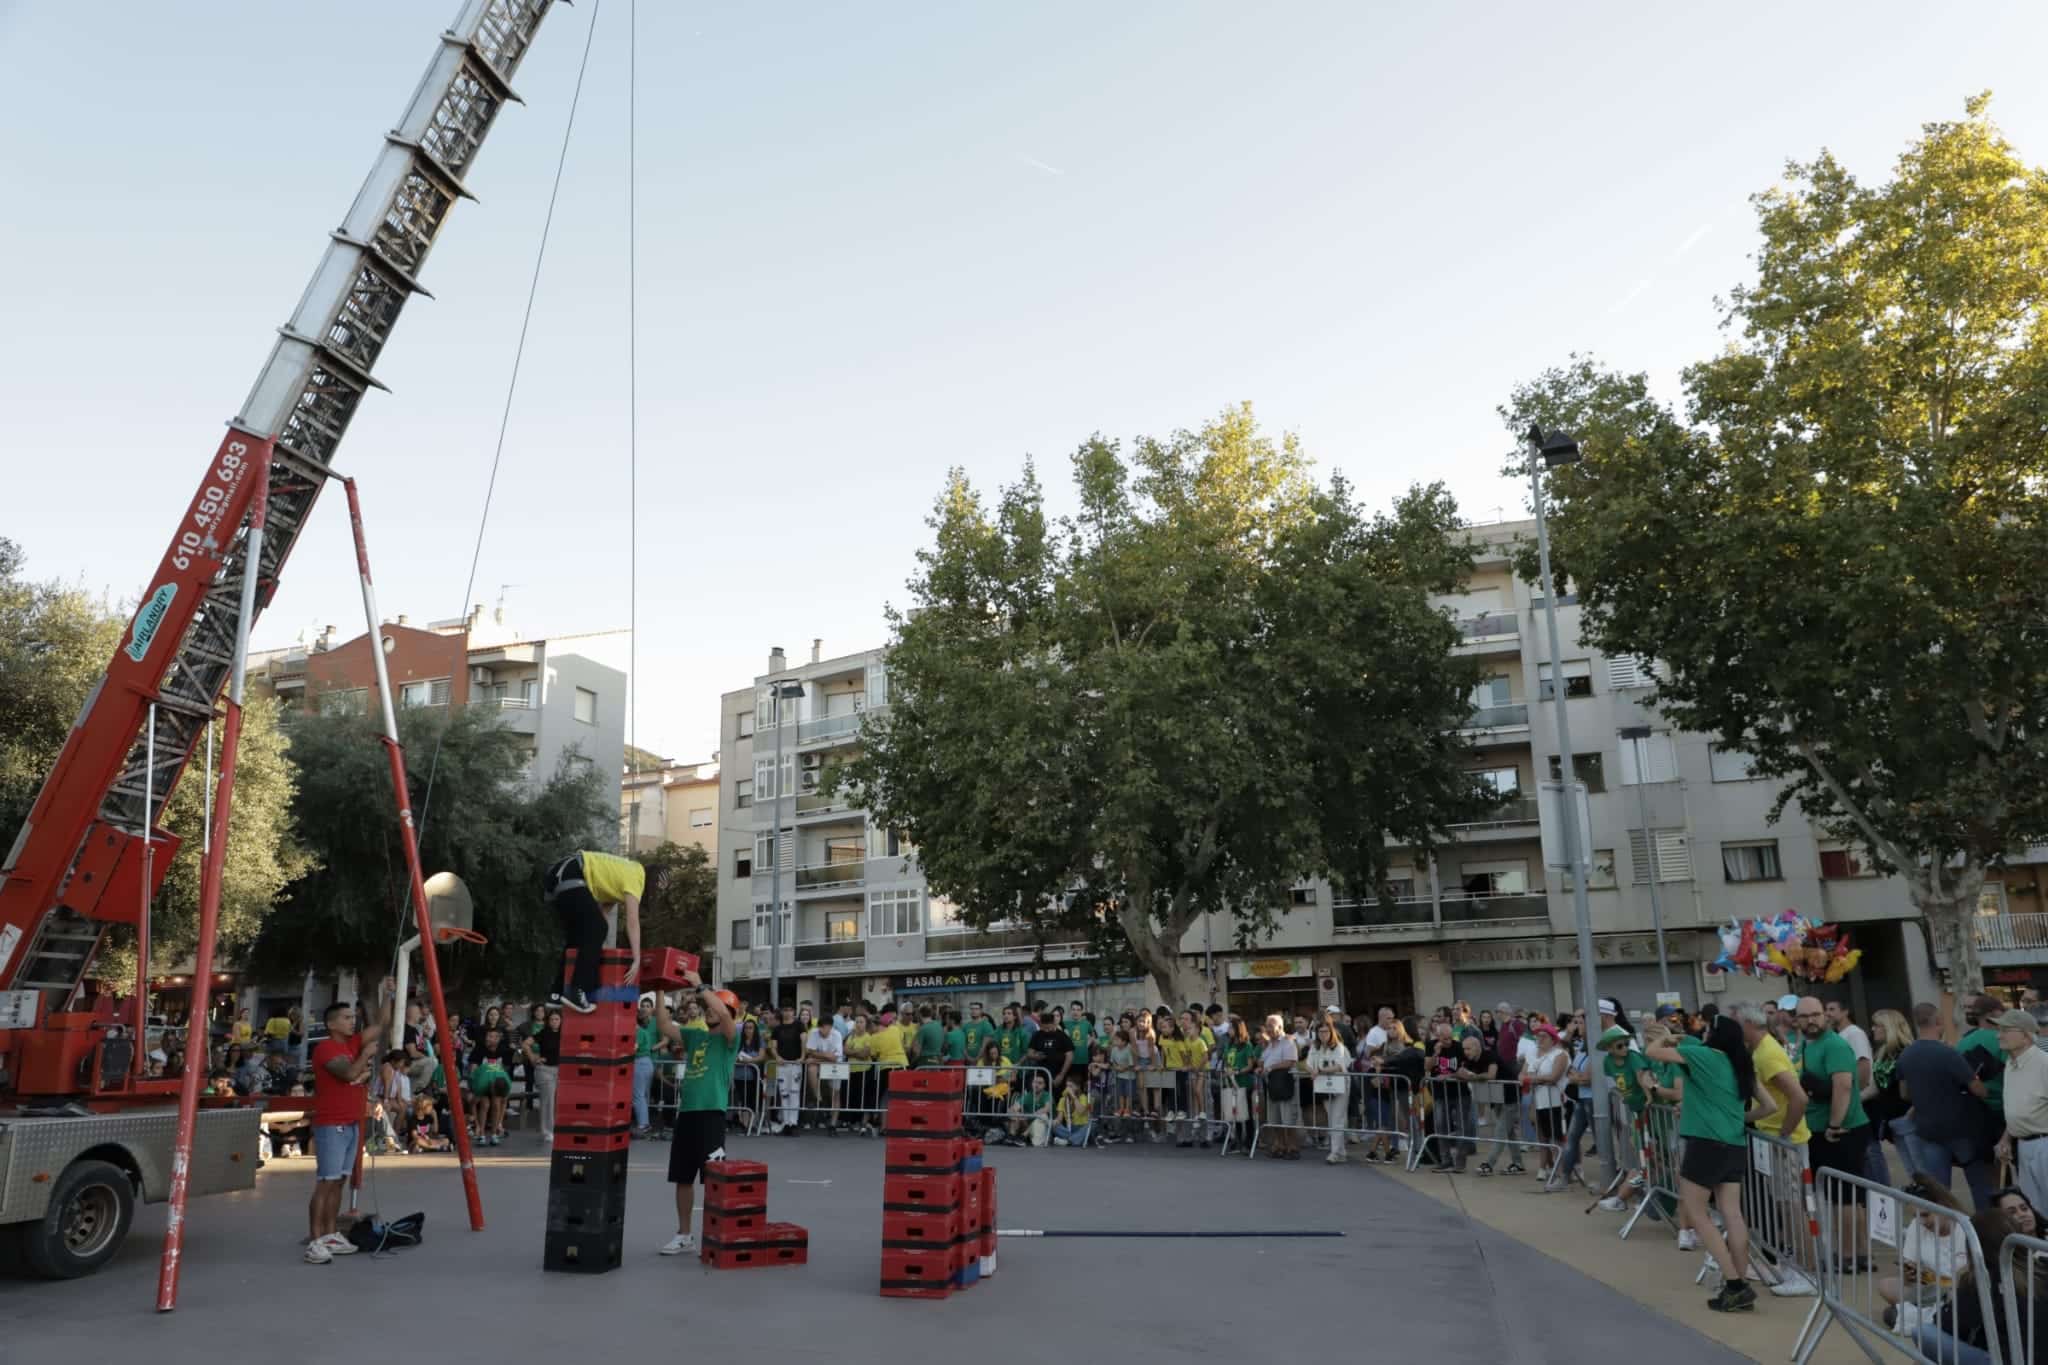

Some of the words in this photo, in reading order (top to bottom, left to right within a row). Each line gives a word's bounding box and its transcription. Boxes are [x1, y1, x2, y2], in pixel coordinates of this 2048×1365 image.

[172, 531, 201, 570] 610
[194, 486, 225, 528] 450
[217, 441, 247, 482] 683
[134, 589, 168, 652] AIRLANDRY
[906, 976, 943, 988] BASAR
[963, 974, 977, 985] YE
